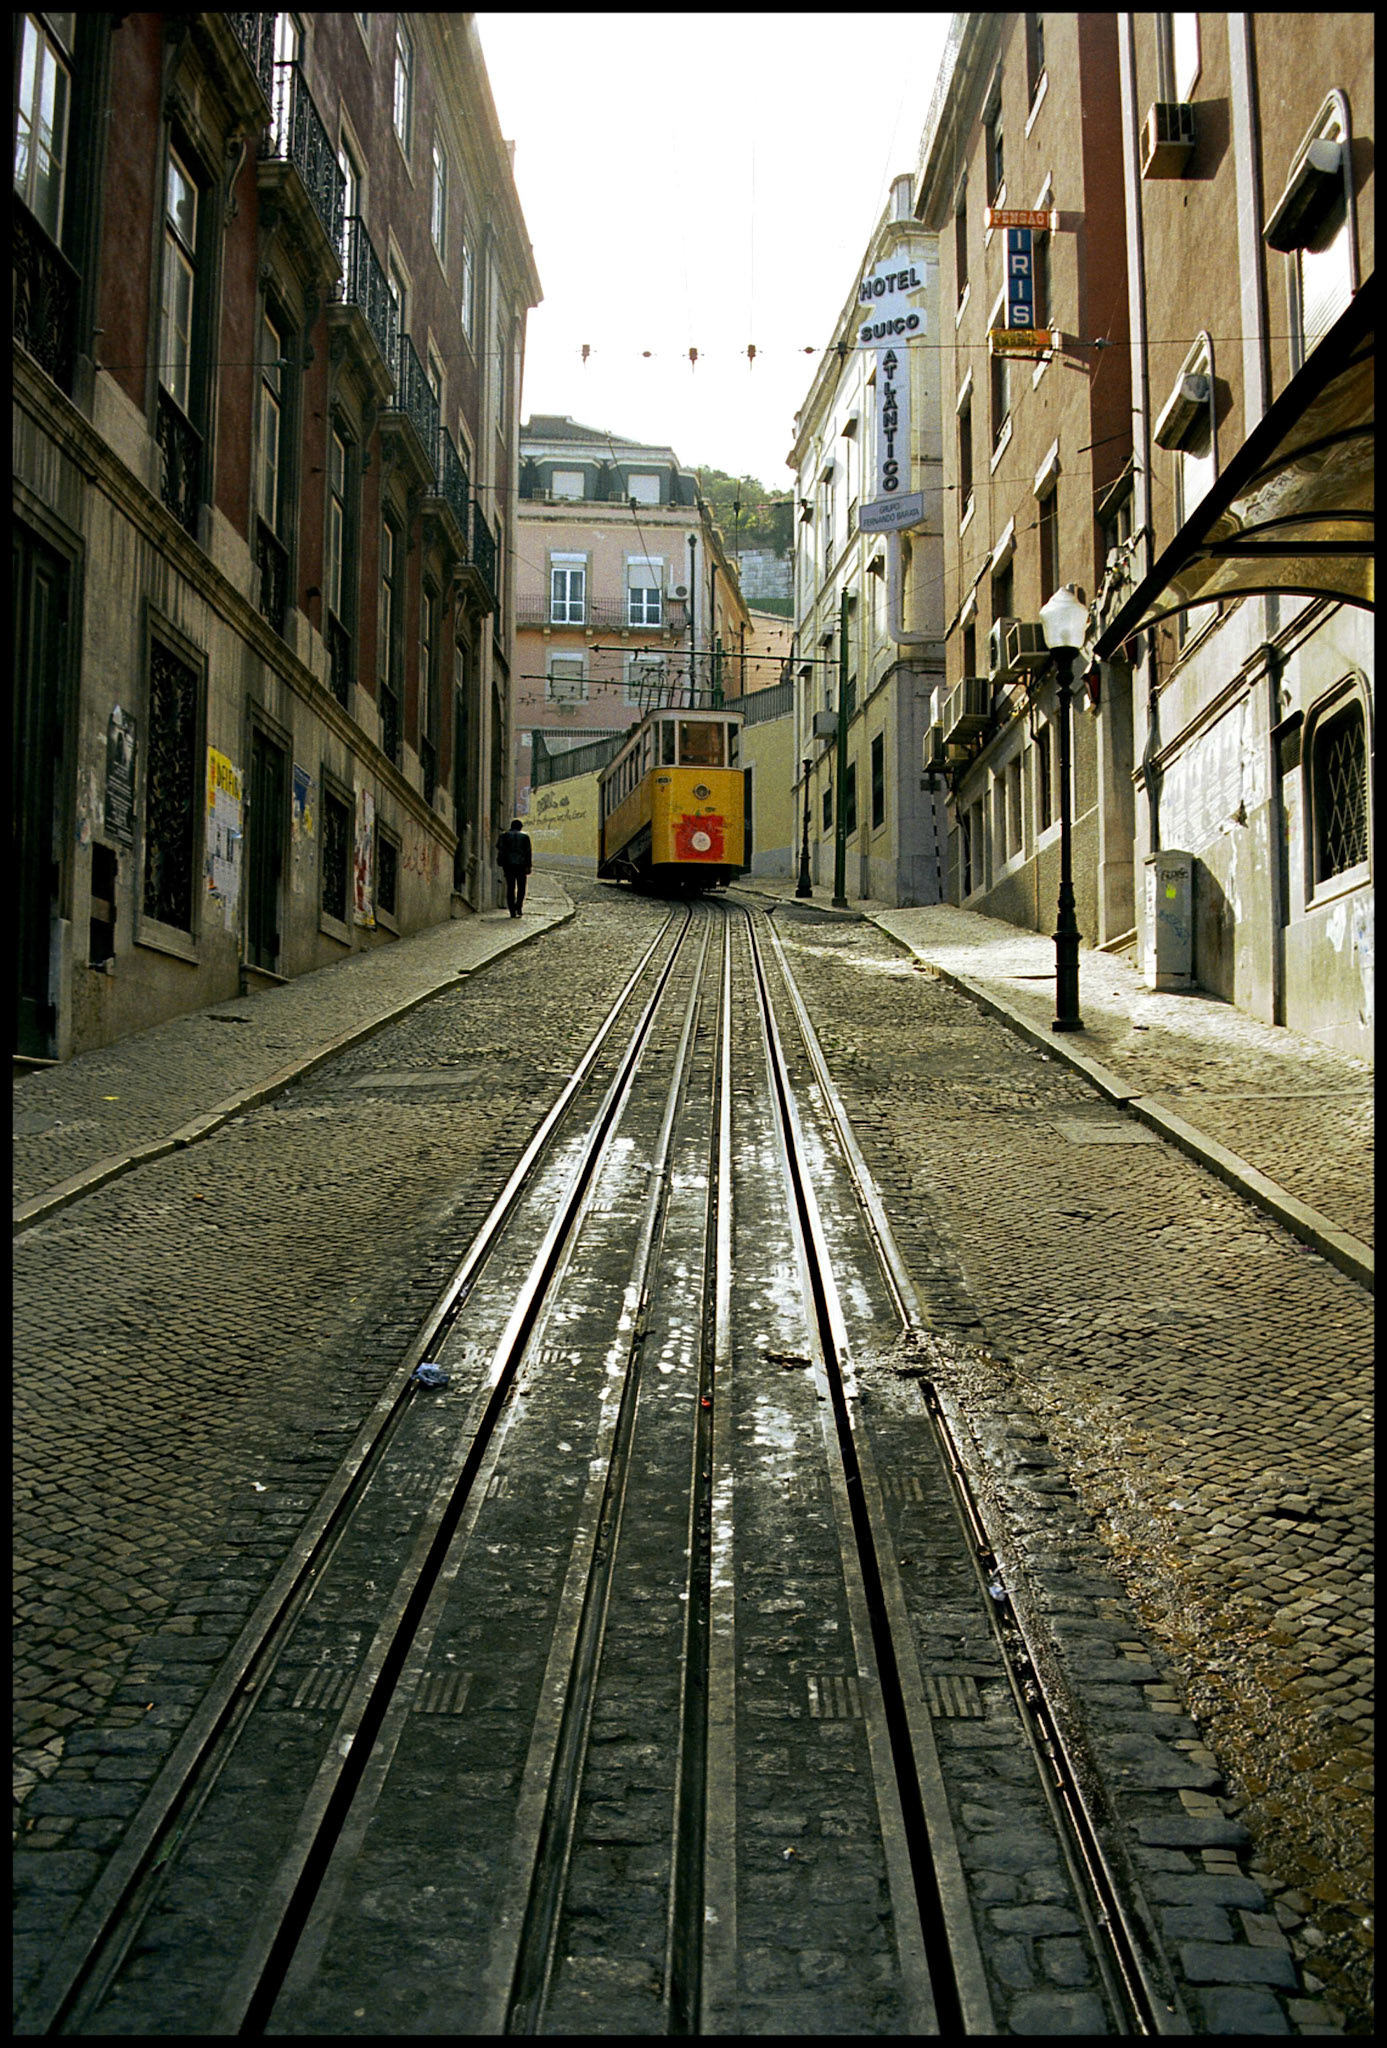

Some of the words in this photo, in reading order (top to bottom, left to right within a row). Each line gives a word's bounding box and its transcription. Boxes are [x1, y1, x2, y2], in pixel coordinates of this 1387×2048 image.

[860, 268, 921, 301] HOTEL
[1011, 230, 1030, 325] IRIS
[896, 507, 920, 521] BARATA
